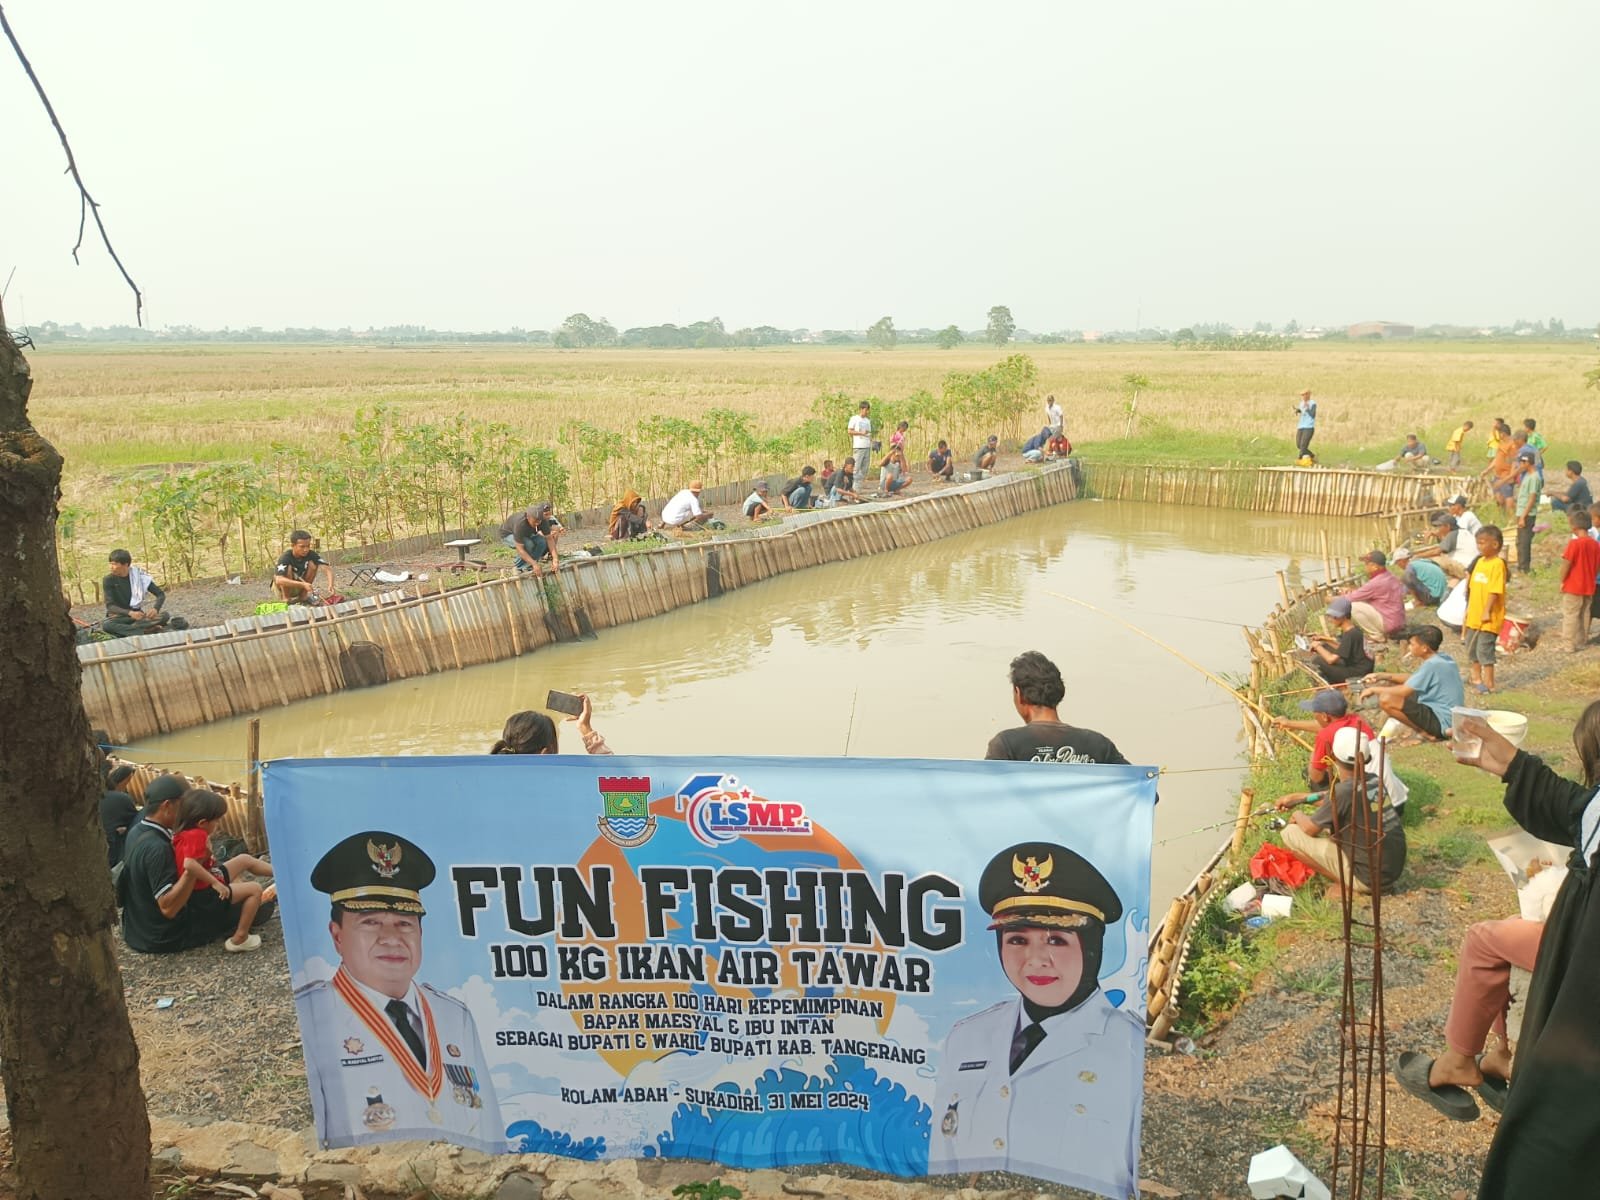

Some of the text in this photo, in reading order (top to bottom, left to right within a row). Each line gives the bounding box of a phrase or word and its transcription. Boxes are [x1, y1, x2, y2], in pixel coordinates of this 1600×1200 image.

[453, 867, 962, 951] FUN FISHING
[491, 944, 931, 992] 100 KG IKAN AIR TAWAR
[537, 991, 882, 1017] DALAM RANGKA 100 HARI KEPEMIMPINAN
[583, 1014, 834, 1035] BAPAK MAESYAL & IBU INTAN
[496, 1031, 926, 1064] SEBAGAI BUPATI & WAKIL BUPATI KAB. TANGERANG
[561, 1087, 617, 1105] KOLAM
[623, 1087, 668, 1102] ABAH
[685, 1088, 763, 1112] SUKADIRI,
[768, 1094, 783, 1109] 31
[790, 1094, 823, 1108] MEI
[828, 1093, 869, 1110] 2024
